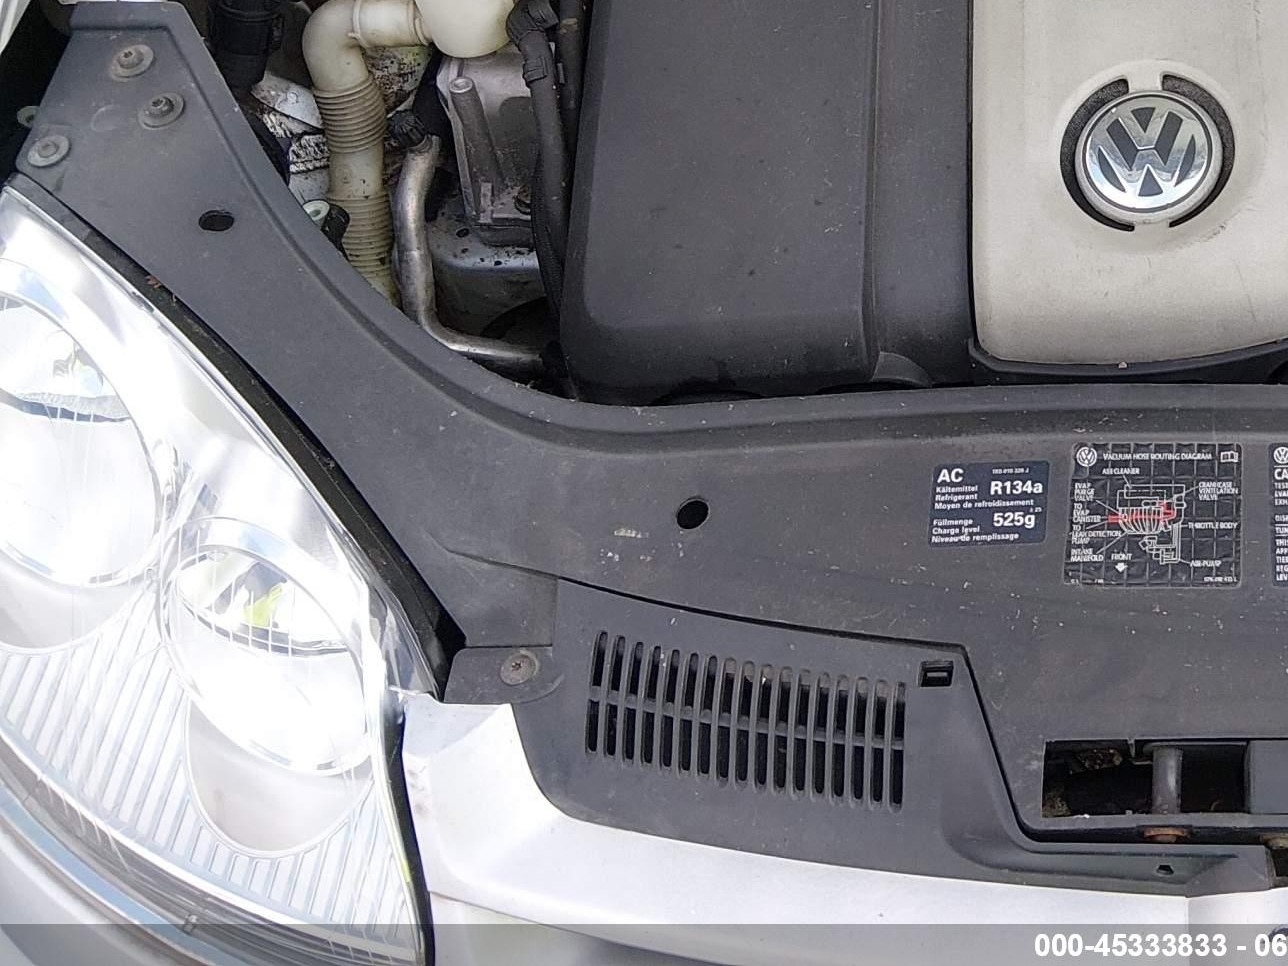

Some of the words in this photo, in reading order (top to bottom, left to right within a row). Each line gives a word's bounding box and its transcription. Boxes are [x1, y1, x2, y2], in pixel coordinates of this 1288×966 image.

[1102, 452, 1132, 460] VACUUM
[938, 468, 964, 483] AC
[936, 485, 978, 493] Kältemittel
[990, 480, 1043, 495] R134a
[935, 494, 978, 502] Refrigerant
[934, 502, 960, 510] Moyen
[974, 499, 1034, 508] refroidissement
[933, 518, 974, 526] Füllmenge
[993, 512, 1036, 528] 525g
[932, 527, 960, 535] Charge
[962, 526, 980, 535] level
[972, 533, 1020, 542] remplissage
